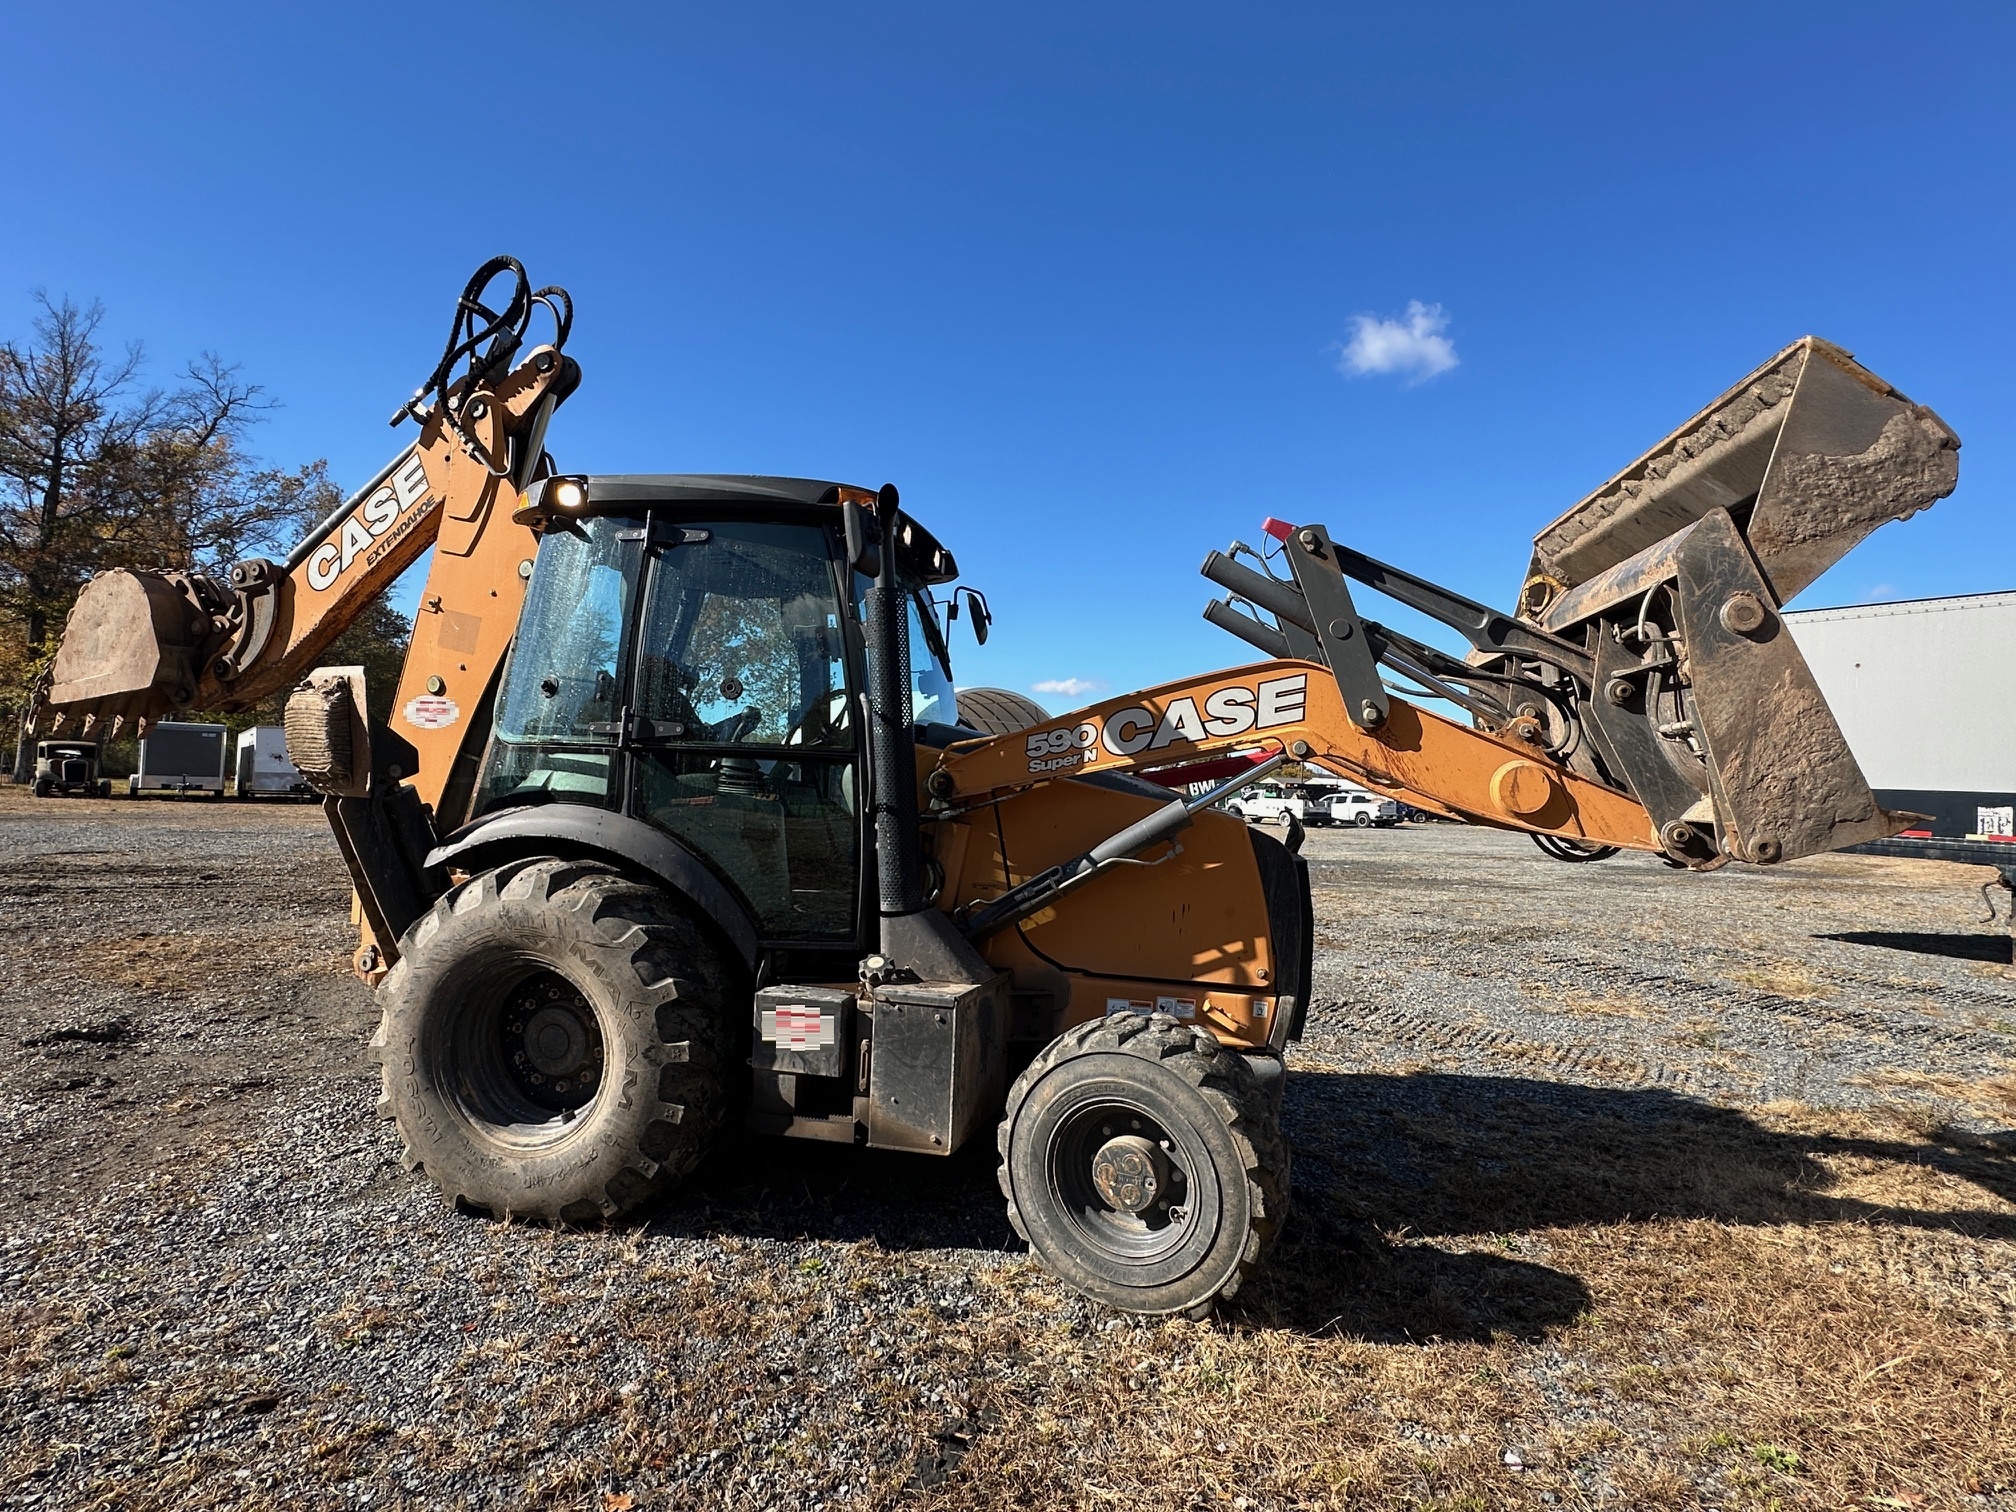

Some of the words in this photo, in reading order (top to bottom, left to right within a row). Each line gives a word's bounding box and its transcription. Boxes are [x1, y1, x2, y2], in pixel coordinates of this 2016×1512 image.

[306, 451, 430, 591] CASE
[366, 494, 436, 566] EXTENDAHOE
[1025, 722, 1098, 757] 590
[1101, 673, 1307, 756] CASE
[1028, 754, 1081, 773] Super
[1082, 748, 1097, 764] N
